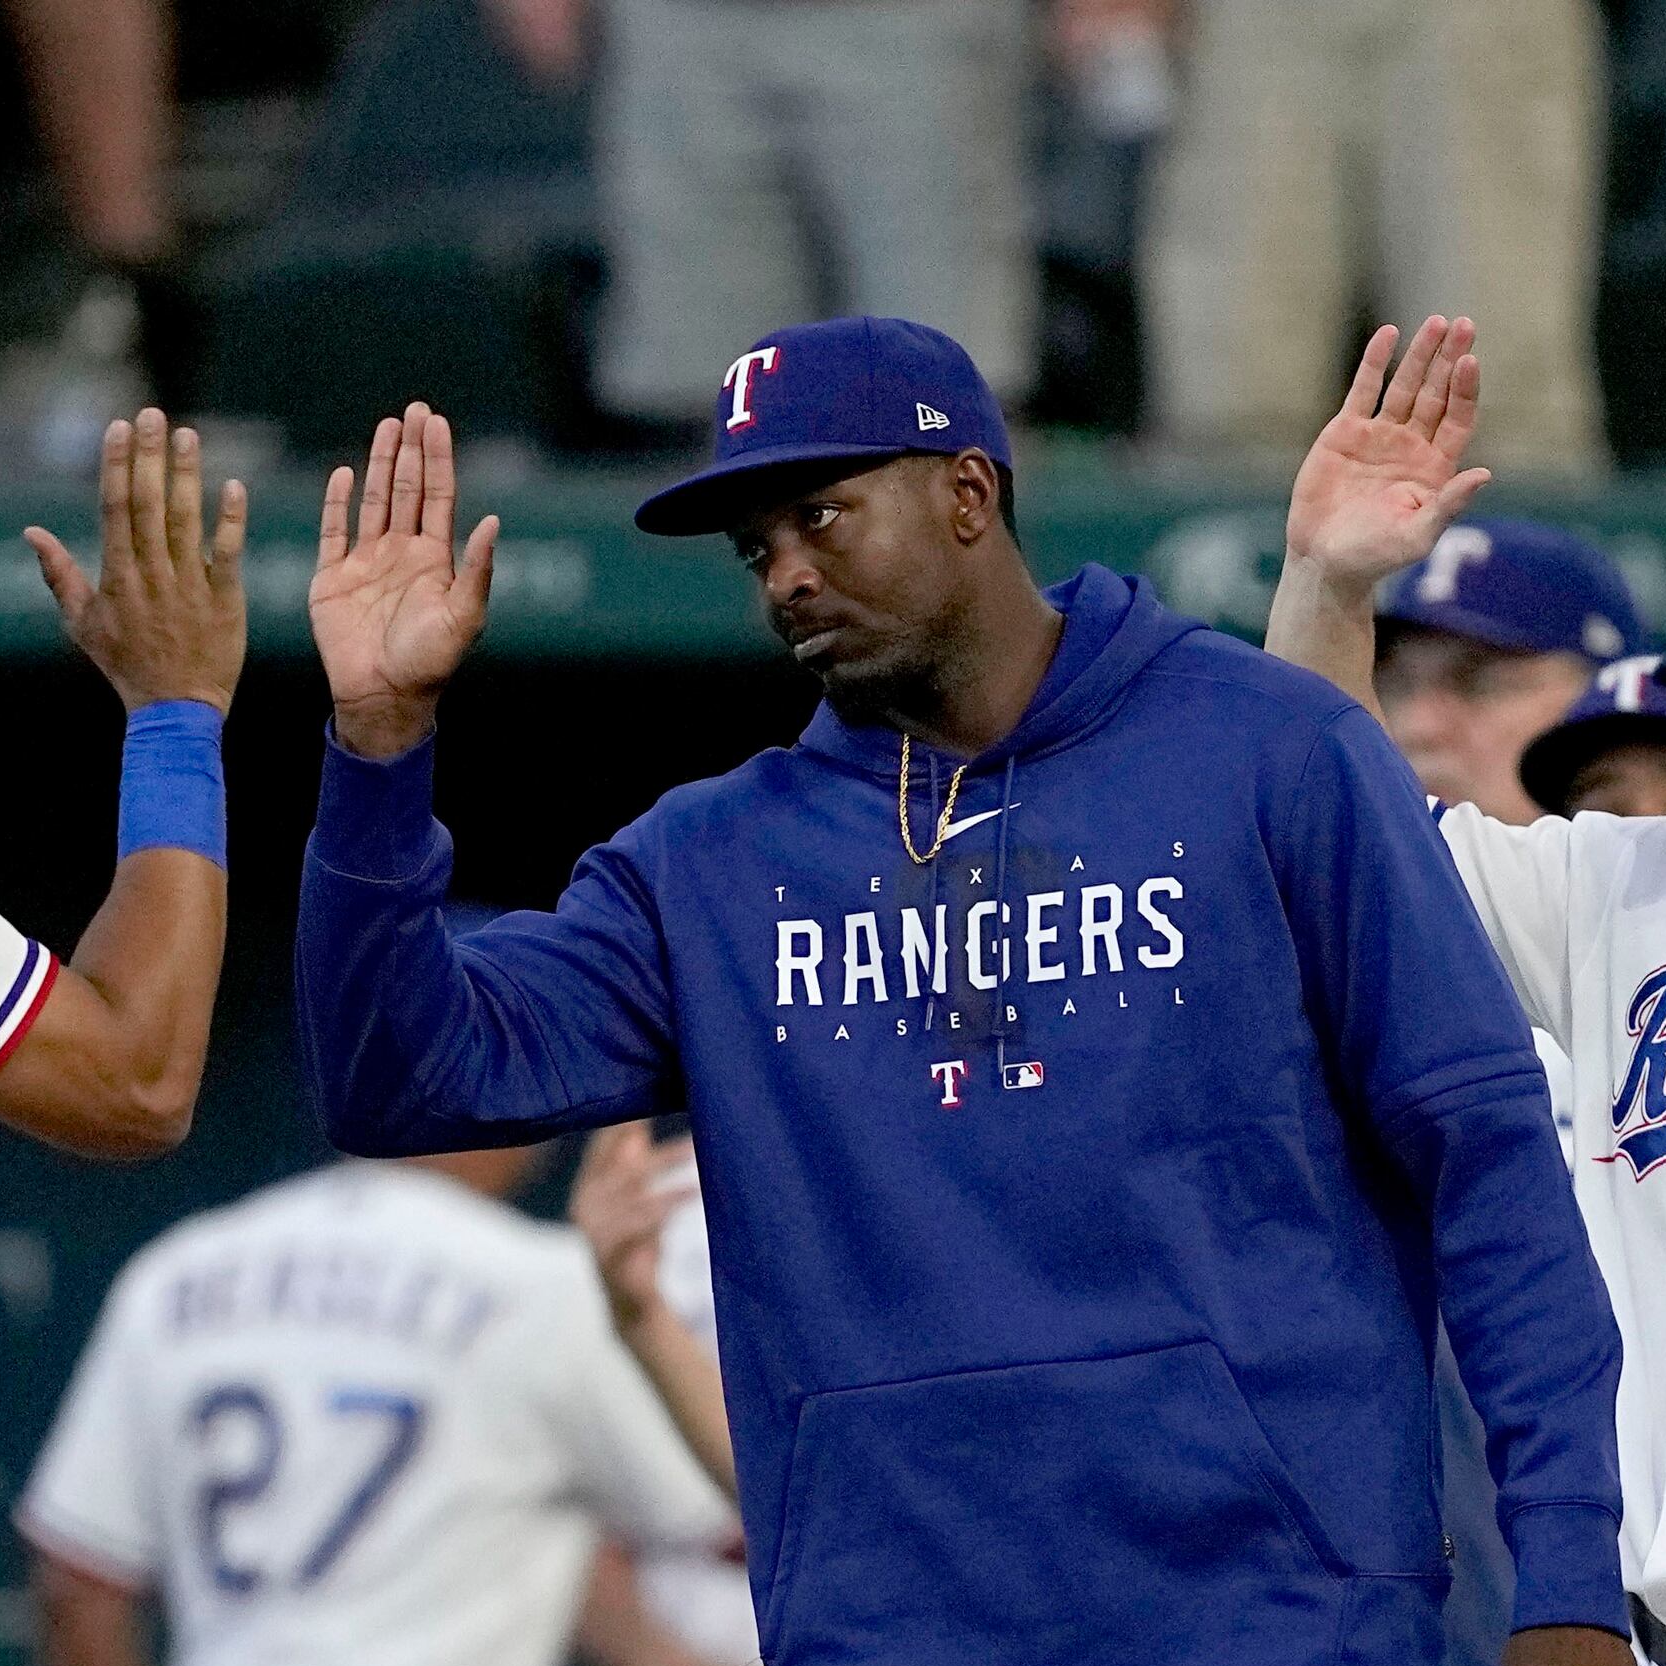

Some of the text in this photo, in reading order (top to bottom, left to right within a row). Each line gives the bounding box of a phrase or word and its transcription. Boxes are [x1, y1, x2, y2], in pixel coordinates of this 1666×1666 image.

[722, 346, 780, 433] T
[774, 841, 1185, 903] TEXAS
[774, 876, 1185, 1006] RANGERS
[774, 986, 1185, 1044] BASEBALL
[930, 1059, 969, 1106] T
[189, 1378, 426, 1594] 27
